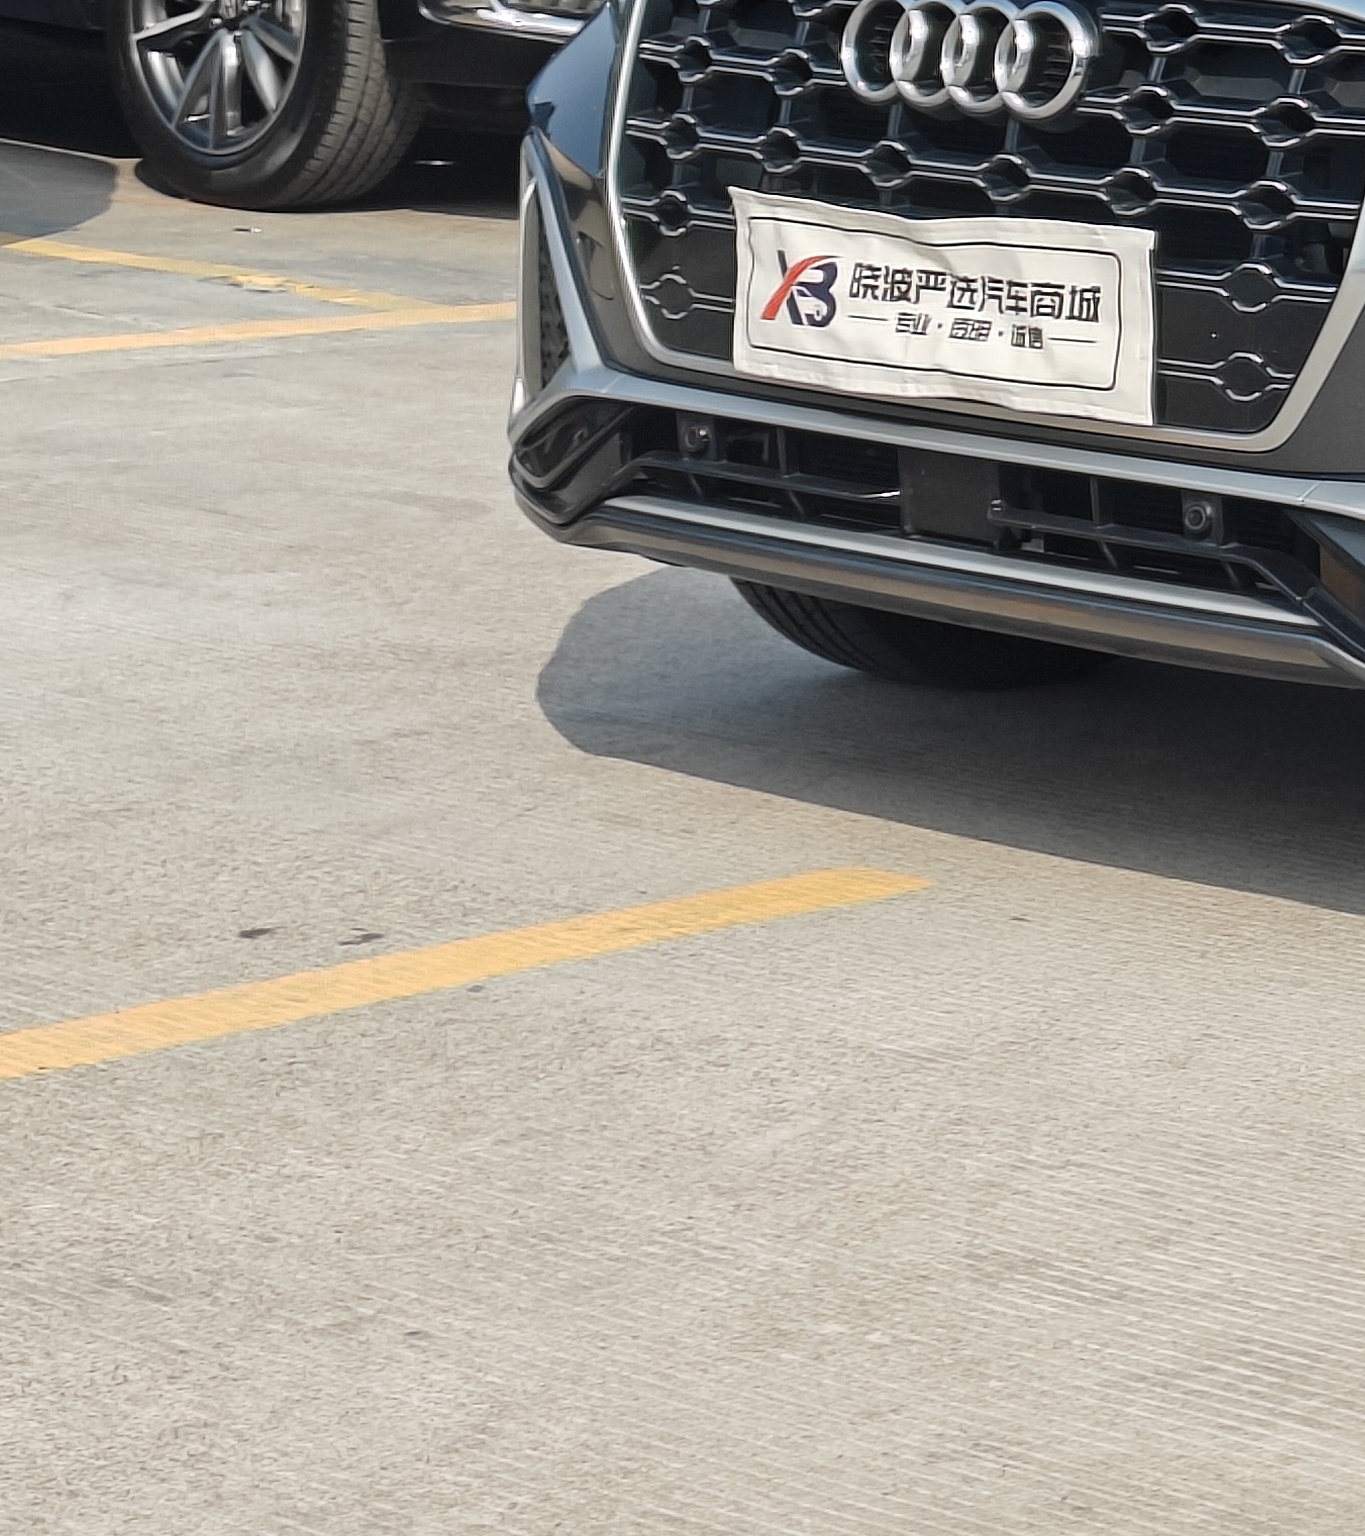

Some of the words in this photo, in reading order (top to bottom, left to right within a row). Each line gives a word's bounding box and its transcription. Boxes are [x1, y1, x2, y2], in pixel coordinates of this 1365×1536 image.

[848, 262, 1102, 323] 晓波严选汽车商城
